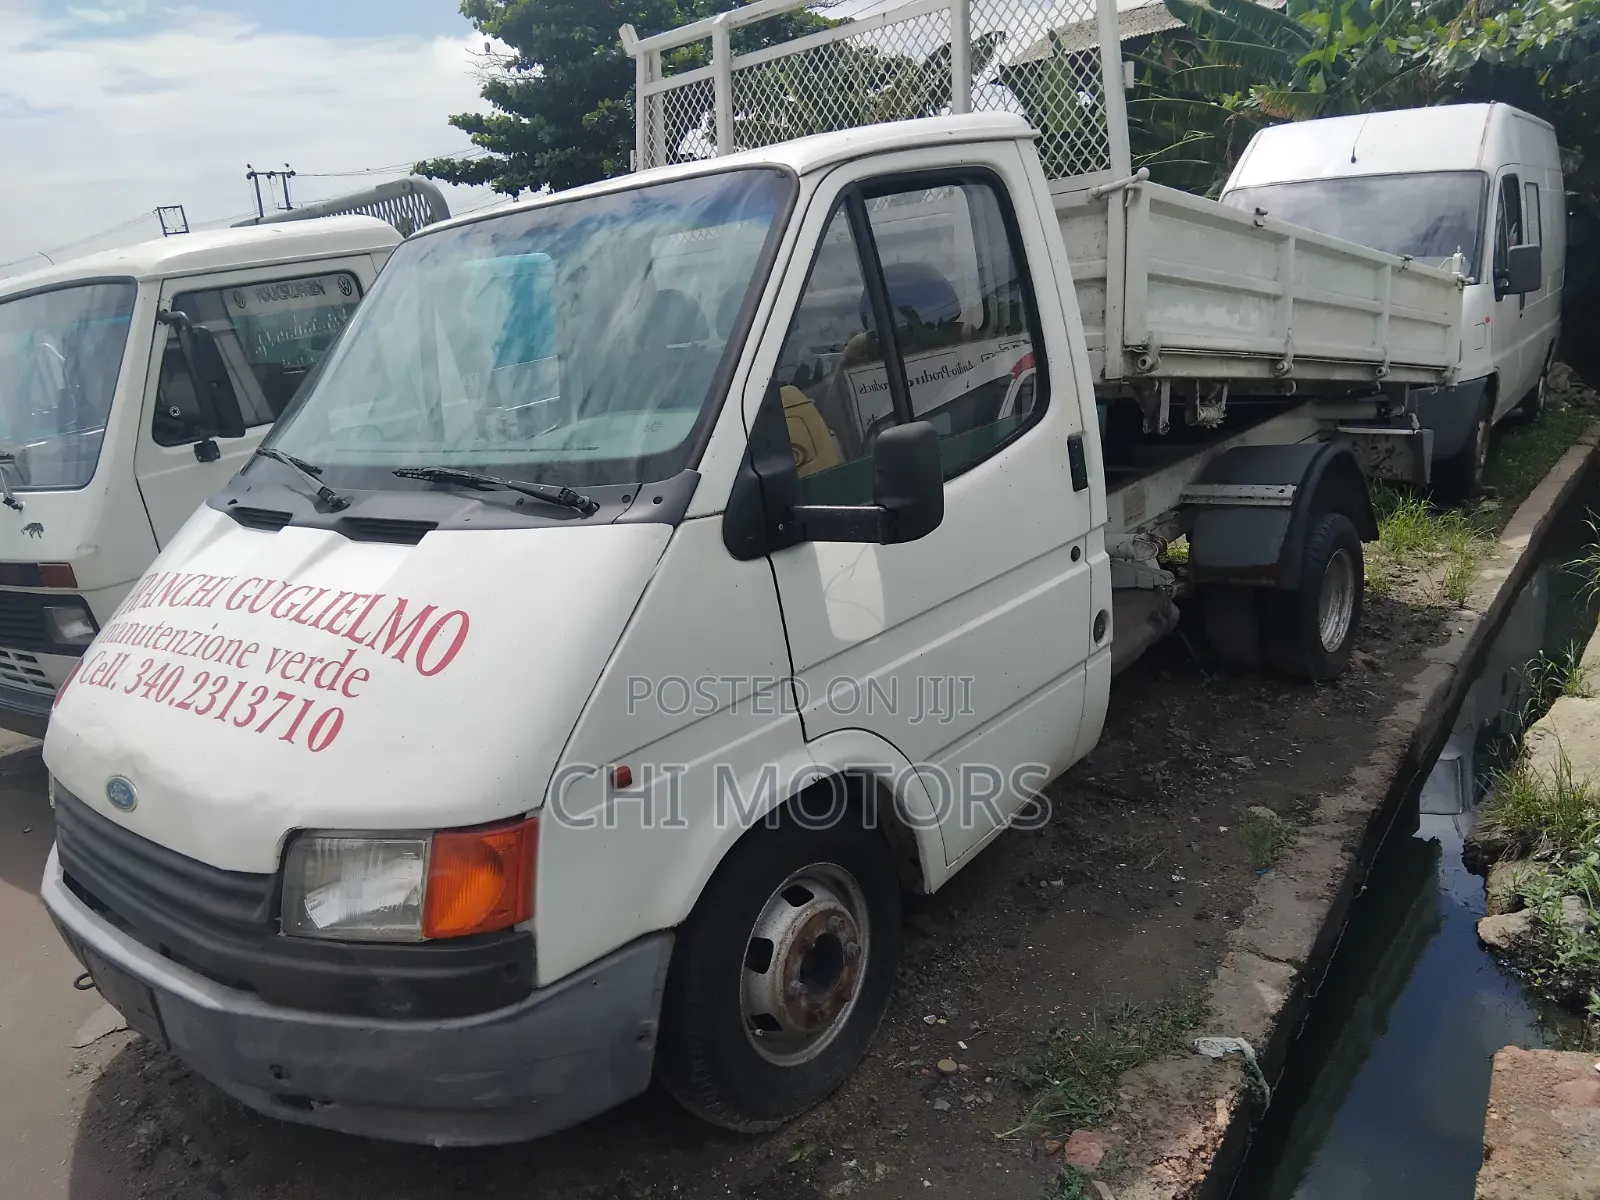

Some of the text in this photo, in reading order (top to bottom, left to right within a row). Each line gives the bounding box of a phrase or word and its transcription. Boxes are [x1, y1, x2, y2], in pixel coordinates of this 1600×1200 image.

[98, 620, 370, 699] manutenzione verde
[225, 577, 470, 677] GUGLIELMO
[124, 658, 344, 753] 340.2313710
